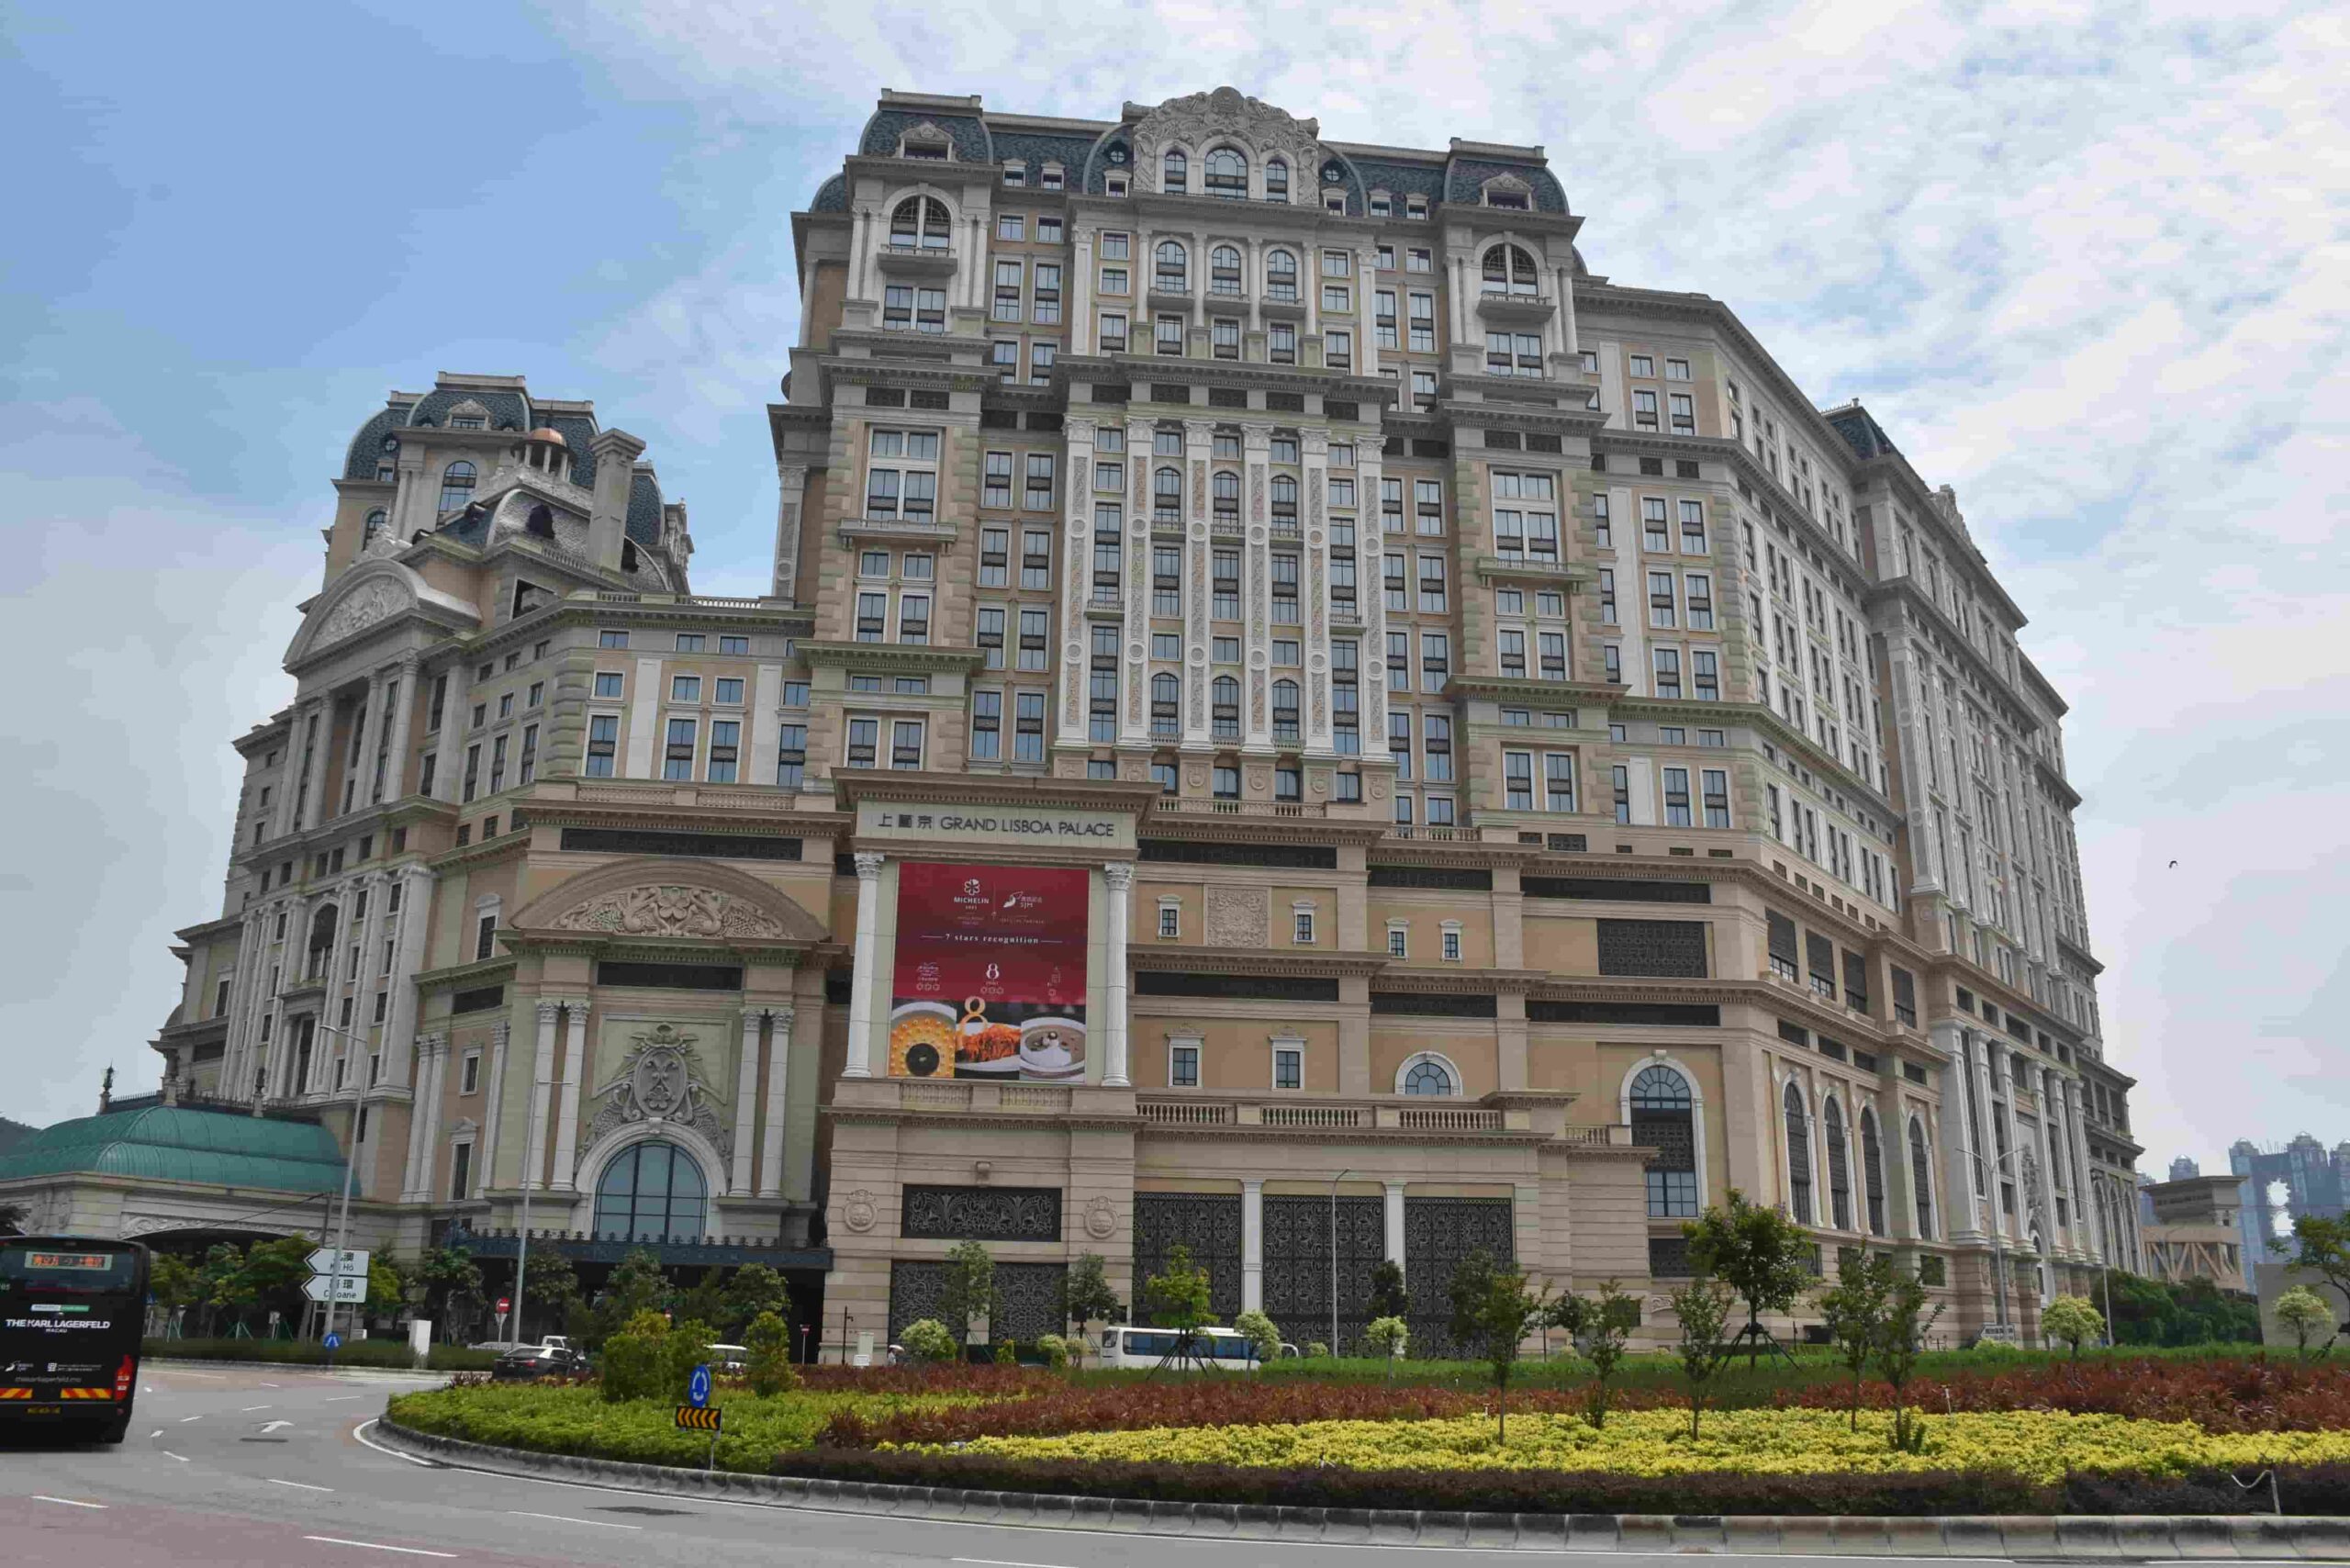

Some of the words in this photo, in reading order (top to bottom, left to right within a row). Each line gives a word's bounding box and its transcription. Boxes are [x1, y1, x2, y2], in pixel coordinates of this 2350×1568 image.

[940, 815, 997, 832] GRAND
[1002, 818, 1053, 834] LISBOA
[1058, 821, 1114, 837] PALACE
[954, 896, 990, 904] MICHELIN
[983, 935, 1038, 945] recognition
[323, 1289, 357, 1299] Coane
[6, 1319, 26, 1327] THE
[27, 1319, 53, 1328] KARL
[54, 1320, 110, 1328] LAGERFELD
